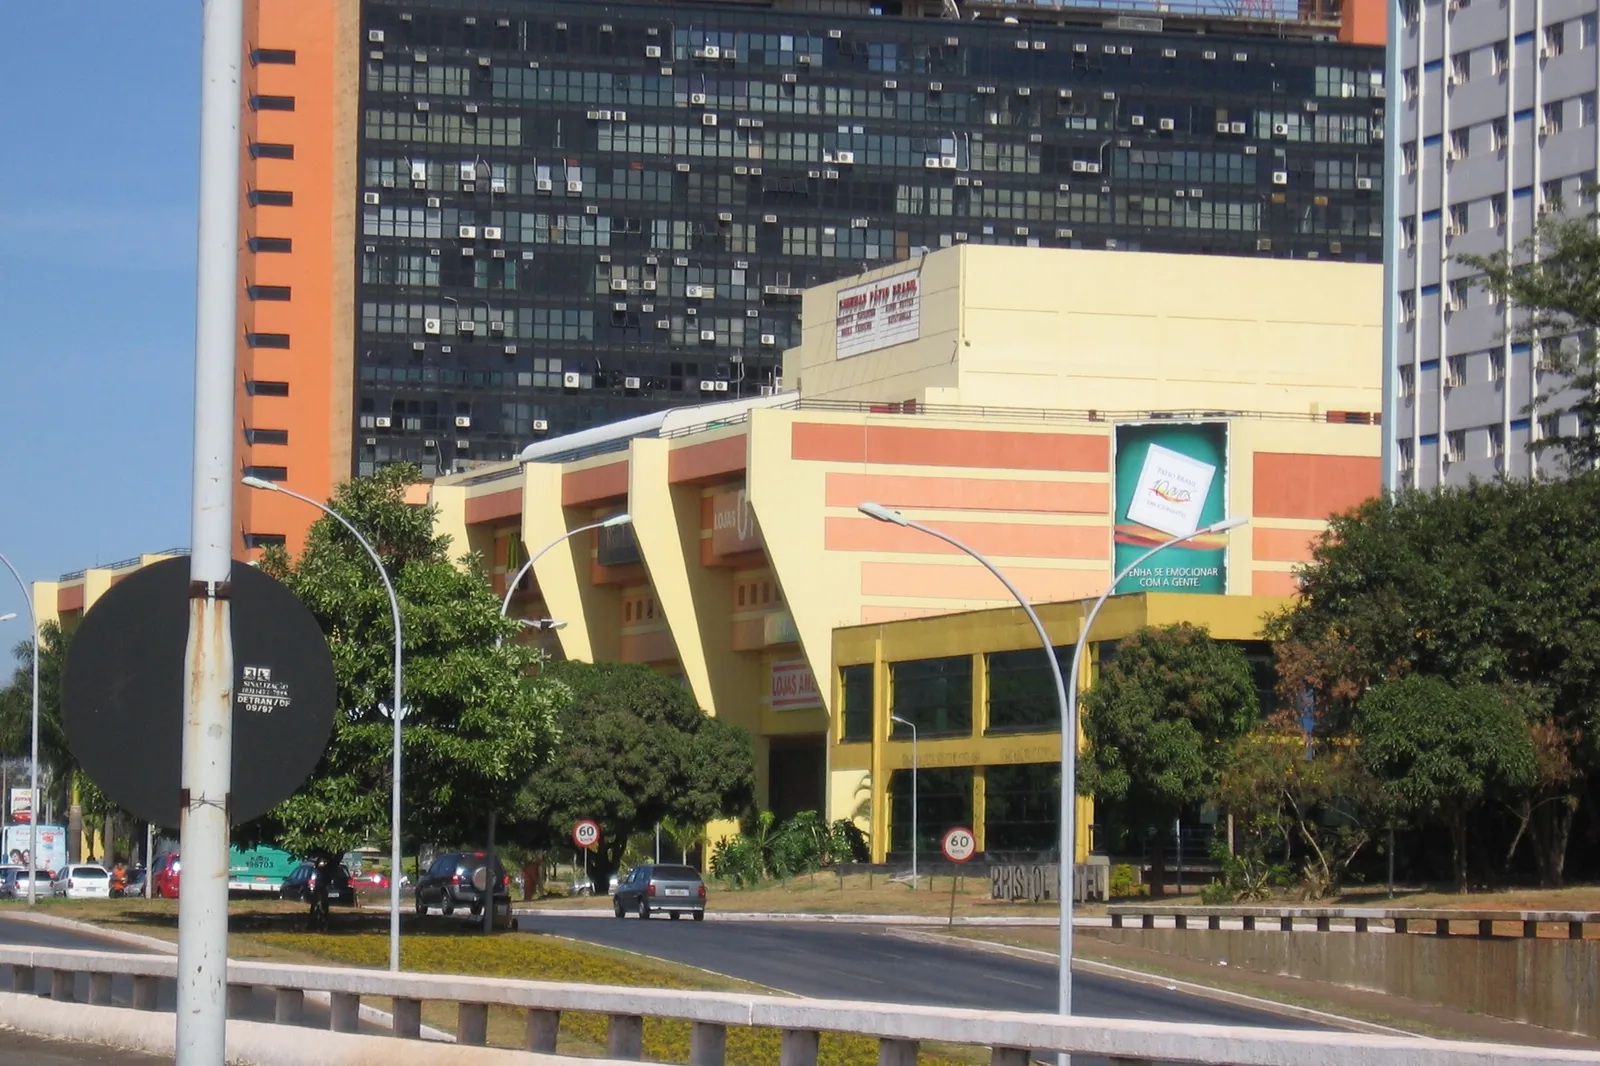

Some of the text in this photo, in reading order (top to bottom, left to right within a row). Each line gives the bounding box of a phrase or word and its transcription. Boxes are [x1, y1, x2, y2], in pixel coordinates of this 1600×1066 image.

[714, 509, 736, 530] LOJAS
[1154, 567, 1164, 576] SE
[1165, 567, 1218, 577] EMOCIONAR
[1139, 577, 1201, 588] COM A GENTE.
[773, 674, 797, 697] LOJAS
[245, 703, 273, 713] 09/97
[579, 826, 594, 836] 60
[950, 835, 969, 848] 60
